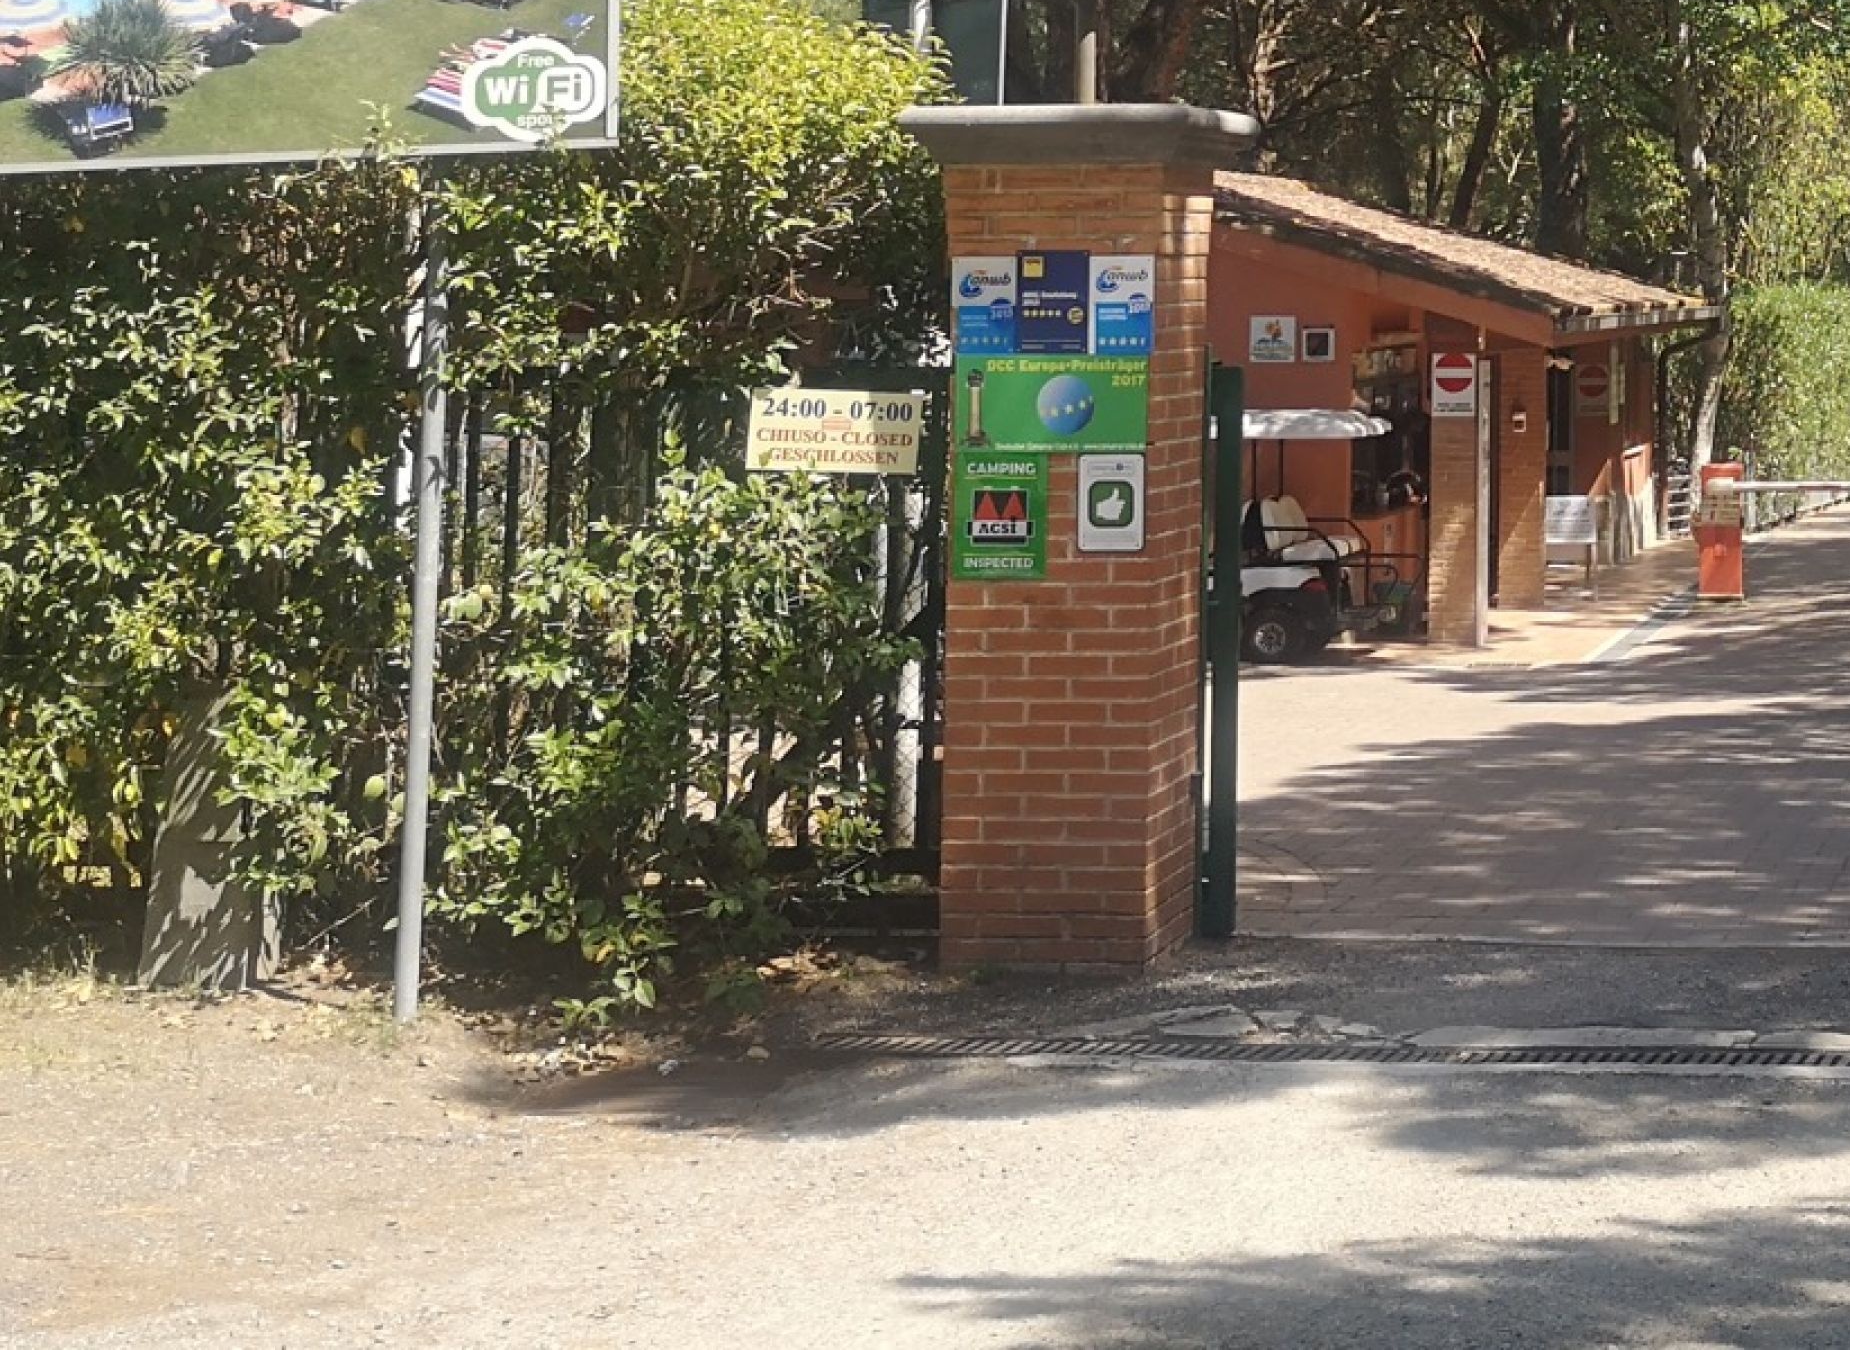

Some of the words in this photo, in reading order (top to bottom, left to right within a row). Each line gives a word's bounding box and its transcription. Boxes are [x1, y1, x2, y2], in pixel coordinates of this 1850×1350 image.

[517, 53, 555, 68] Free
[986, 359, 1015, 372] DCC
[1111, 374, 1148, 387] 2017
[763, 397, 827, 419] 24:00
[850, 400, 913, 422] 07:00
[756, 427, 827, 444] CHIUSO
[841, 431, 913, 447] CLOSED
[769, 447, 899, 465] GESCHLOSSEN
[967, 462, 1037, 476] CAMPING
[962, 557, 1035, 569] INSPECTED
